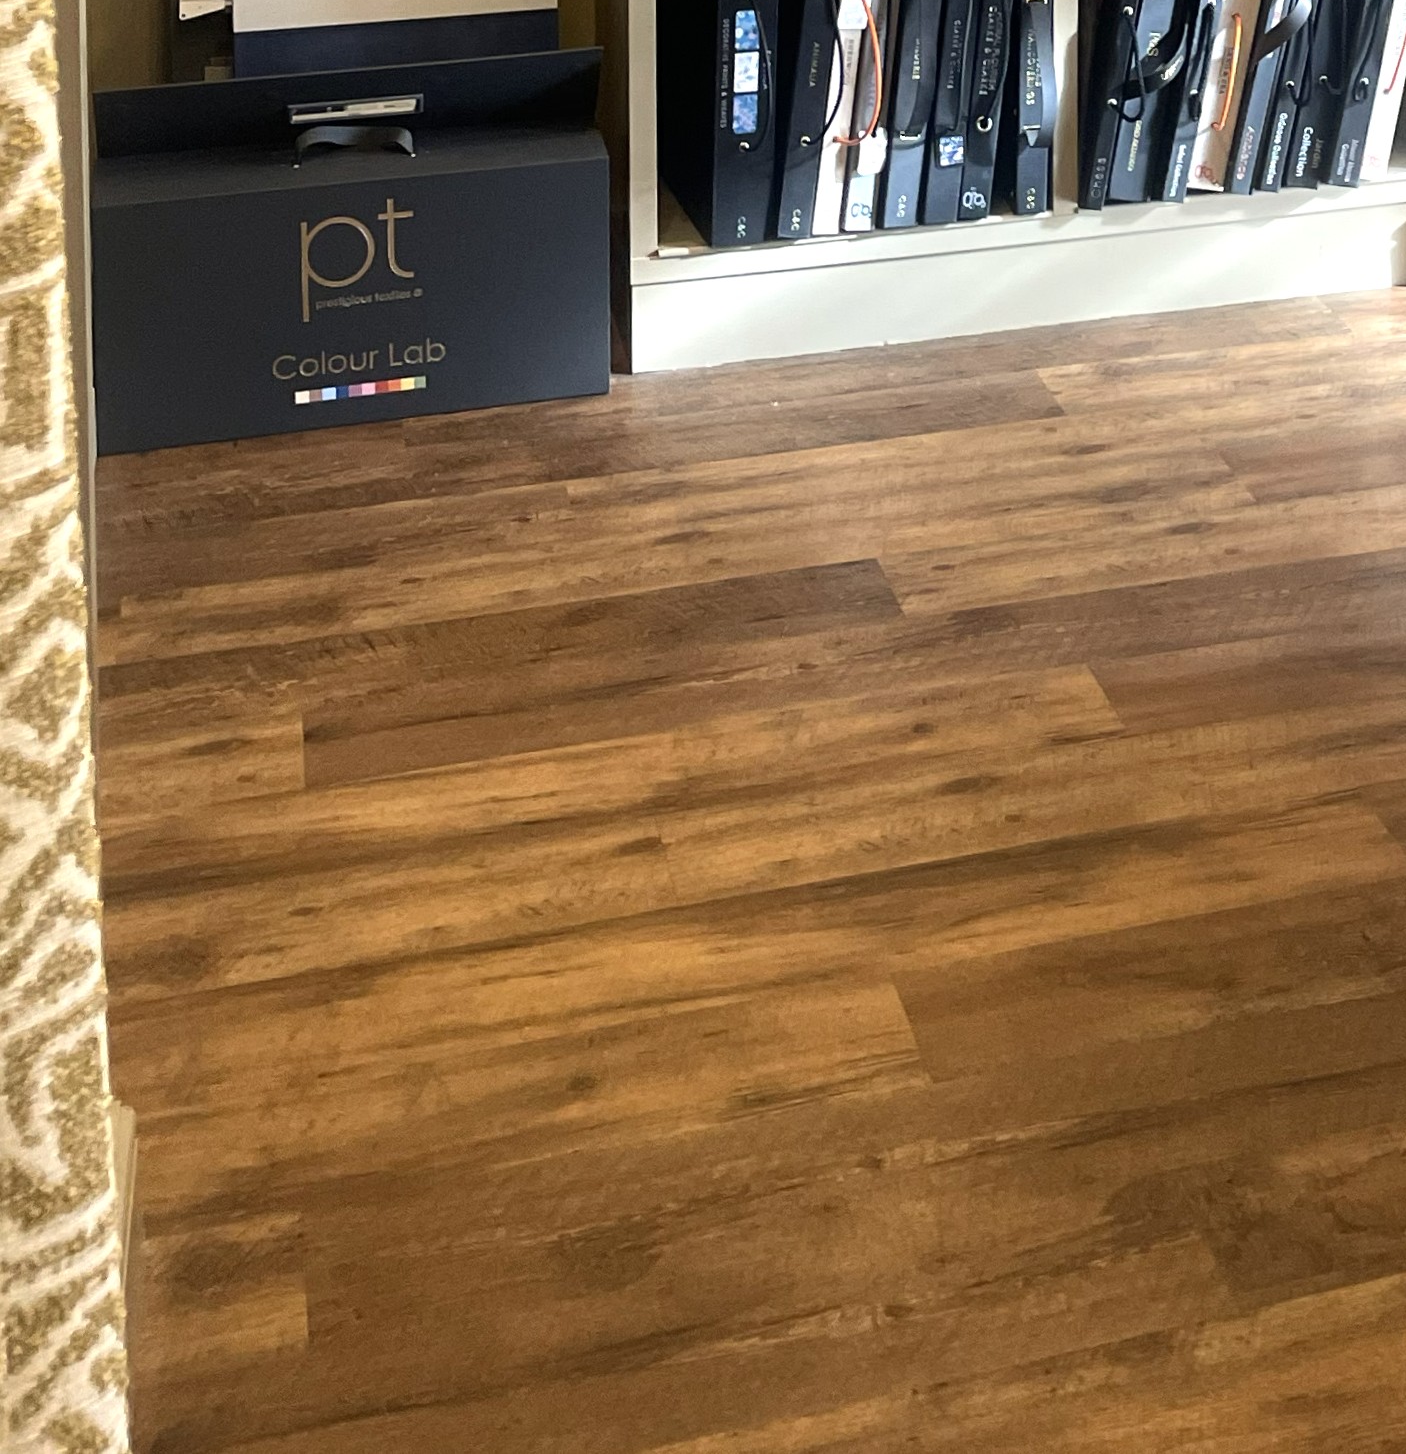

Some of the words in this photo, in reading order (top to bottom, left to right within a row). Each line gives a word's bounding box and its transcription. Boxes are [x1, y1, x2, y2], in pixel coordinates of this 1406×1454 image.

[1295, 125, 1315, 178] Collection
[300, 197, 416, 323] pt
[271, 348, 379, 381] Colour
[388, 337, 447, 367] Lab
